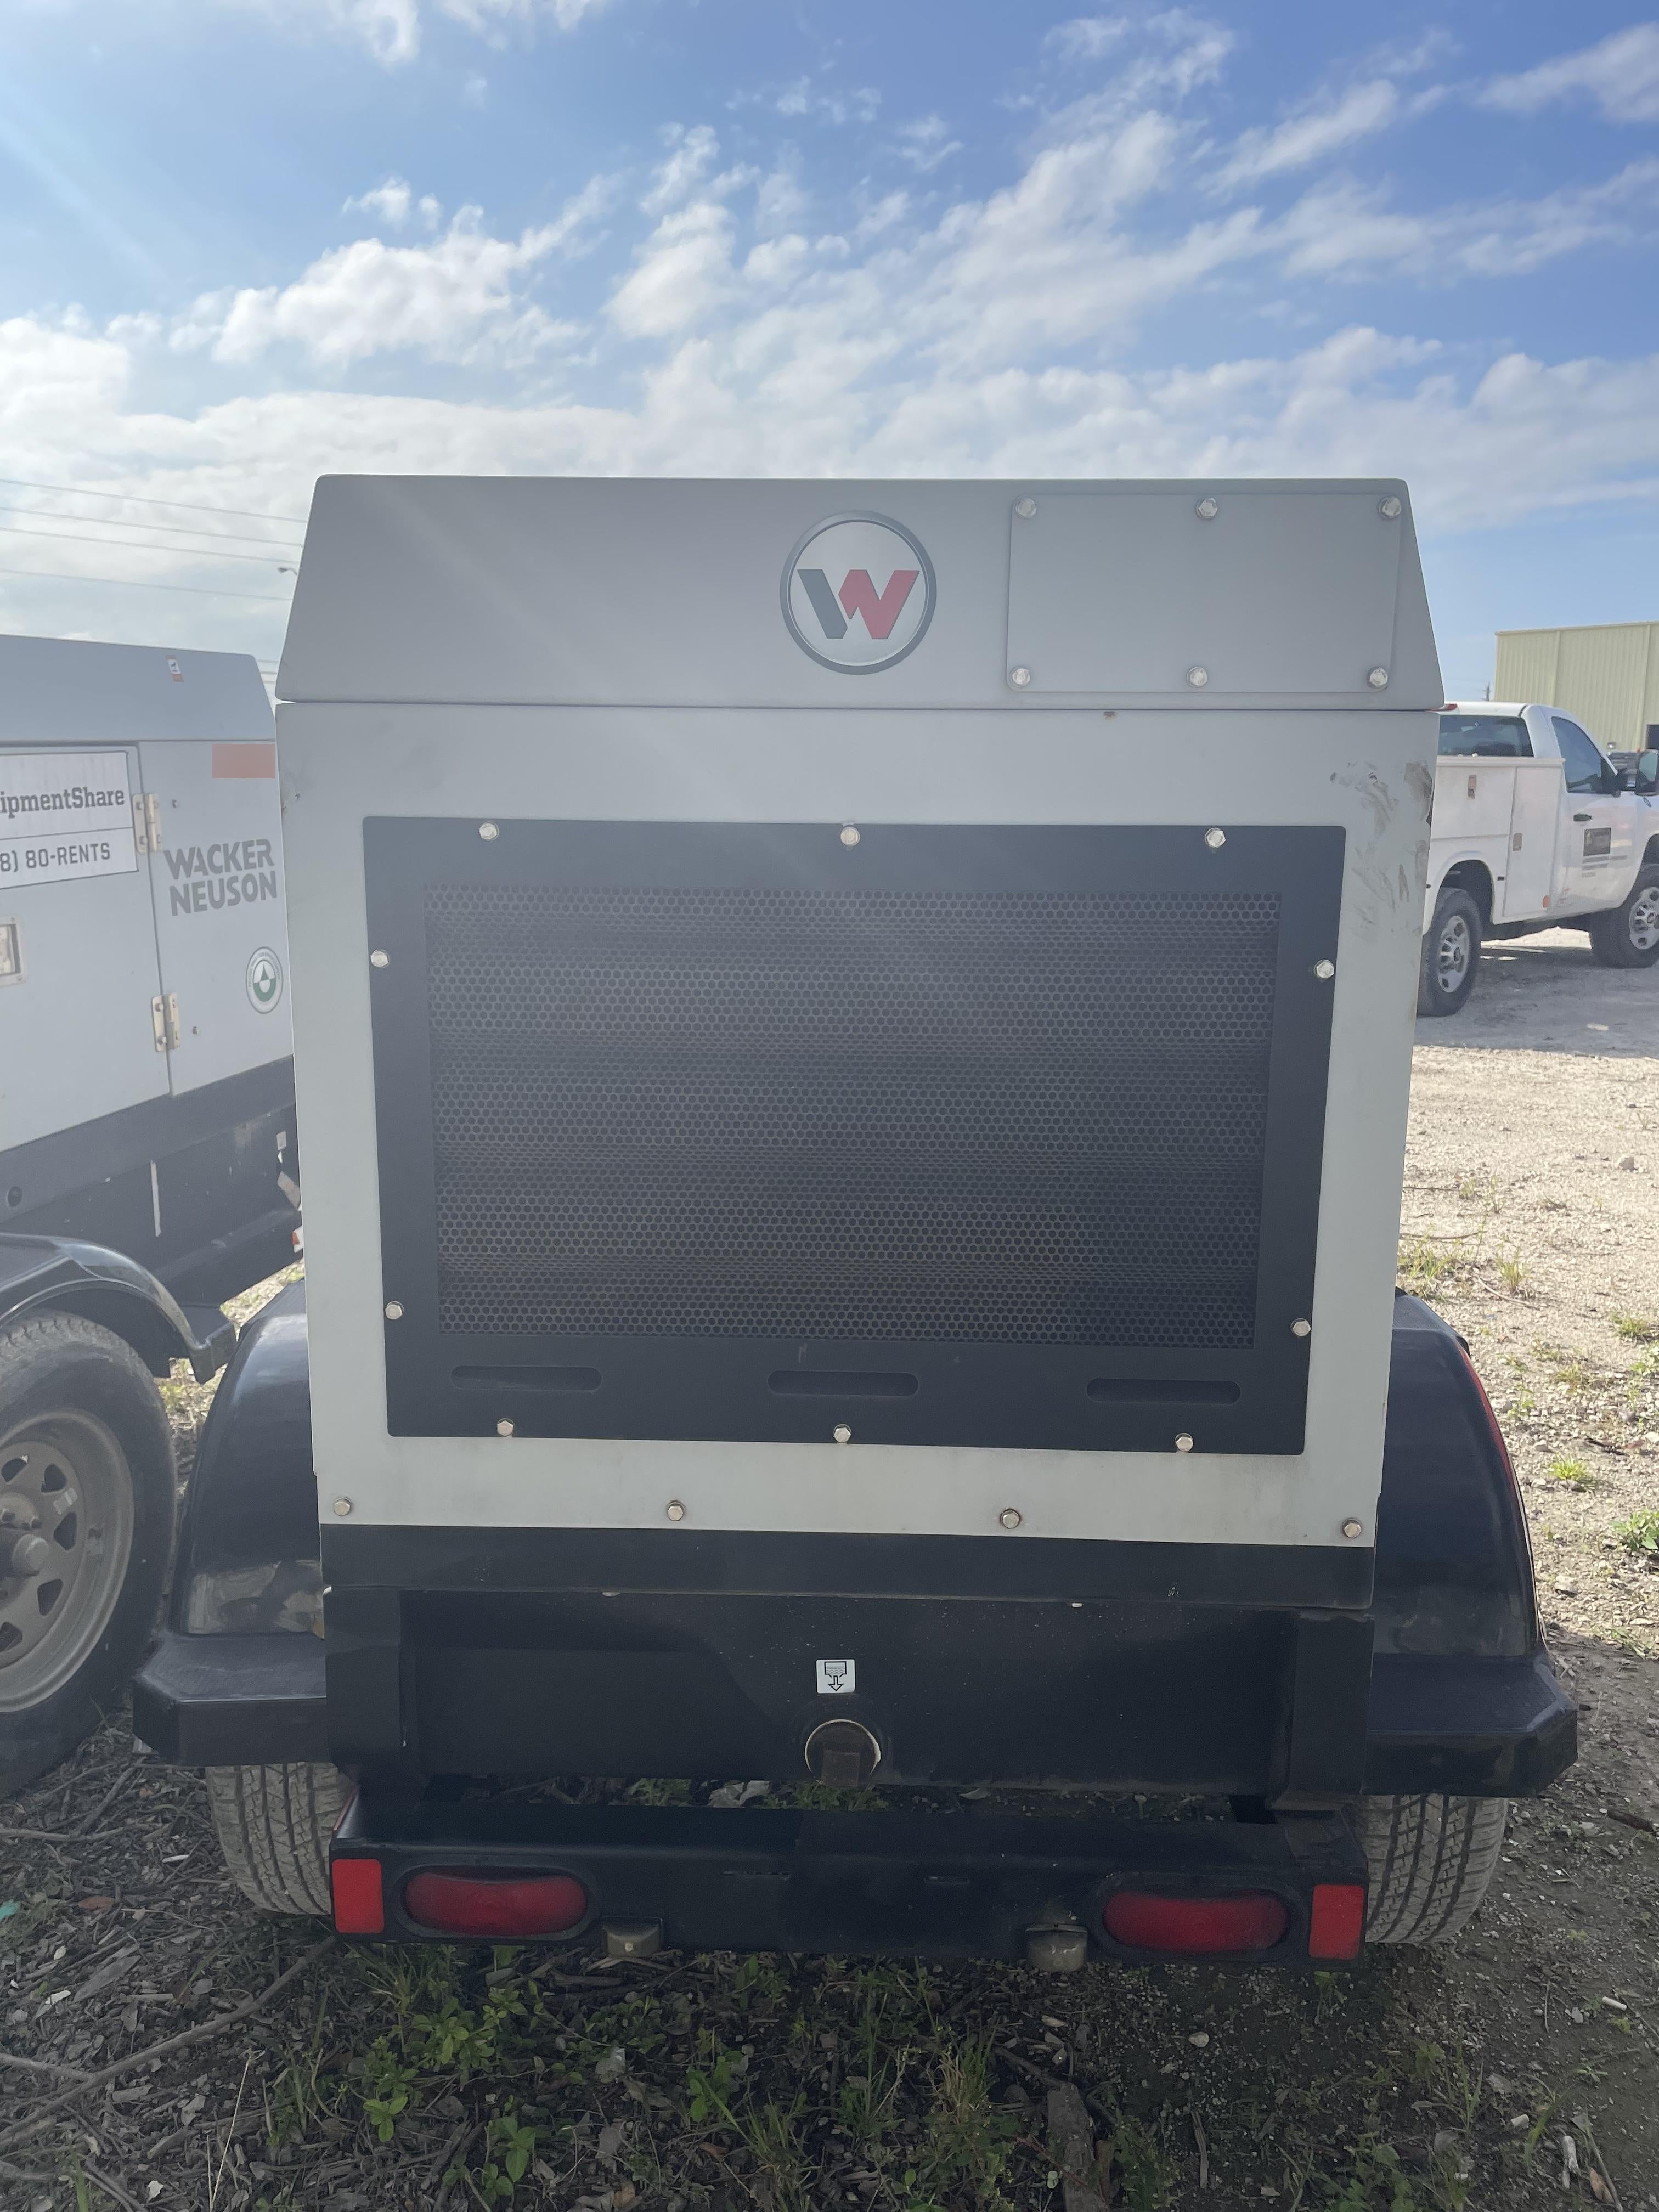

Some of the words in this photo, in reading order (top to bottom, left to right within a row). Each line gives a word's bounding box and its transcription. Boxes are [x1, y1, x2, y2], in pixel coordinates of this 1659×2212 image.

[797, 569, 920, 640] W
[25, 843, 110, 868] 80-RENTS
[163, 839, 275, 880] WACKER
[169, 871, 277, 916] NEUSON
